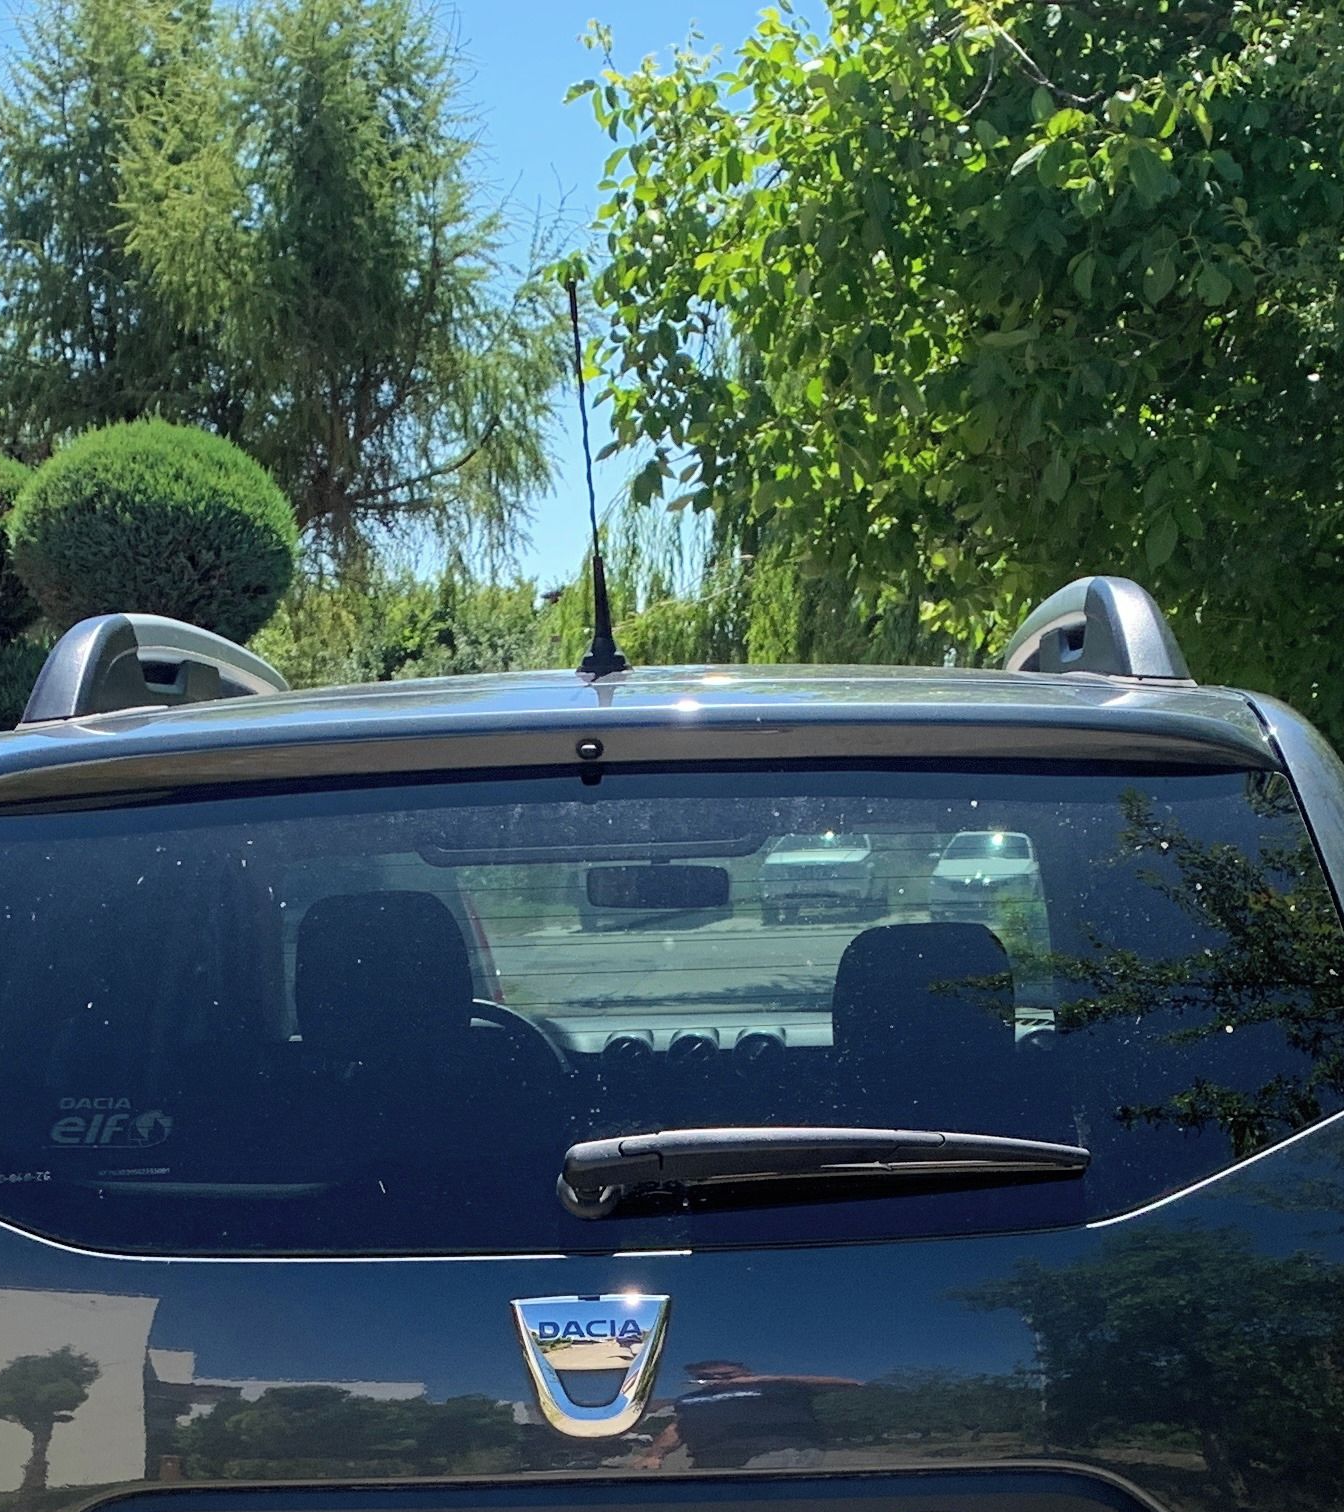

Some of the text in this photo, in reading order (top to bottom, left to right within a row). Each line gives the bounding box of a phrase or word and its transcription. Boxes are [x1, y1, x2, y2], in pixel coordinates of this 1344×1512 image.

[59, 1097, 132, 1110] DACIA
[51, 1113, 130, 1145] elf
[538, 1318, 643, 1340] DACIA
